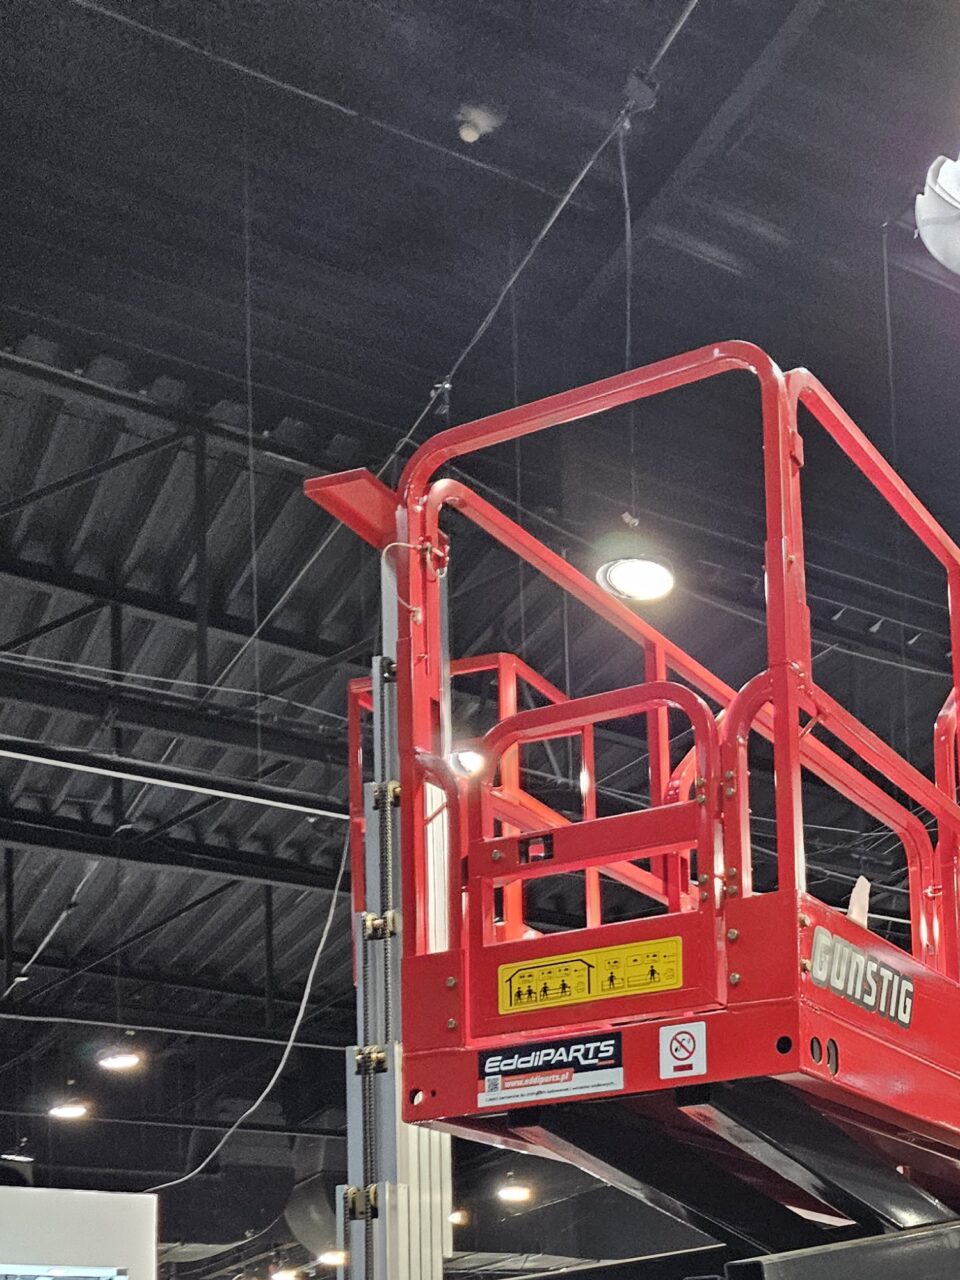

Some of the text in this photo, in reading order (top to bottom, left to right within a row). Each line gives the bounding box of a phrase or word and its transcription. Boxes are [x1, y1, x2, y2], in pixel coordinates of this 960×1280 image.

[811, 926, 914, 1026] GUNSTIG
[485, 1040, 615, 1073] EddiPARTS
[504, 1072, 569, 1088] www.eddiparts.pl
